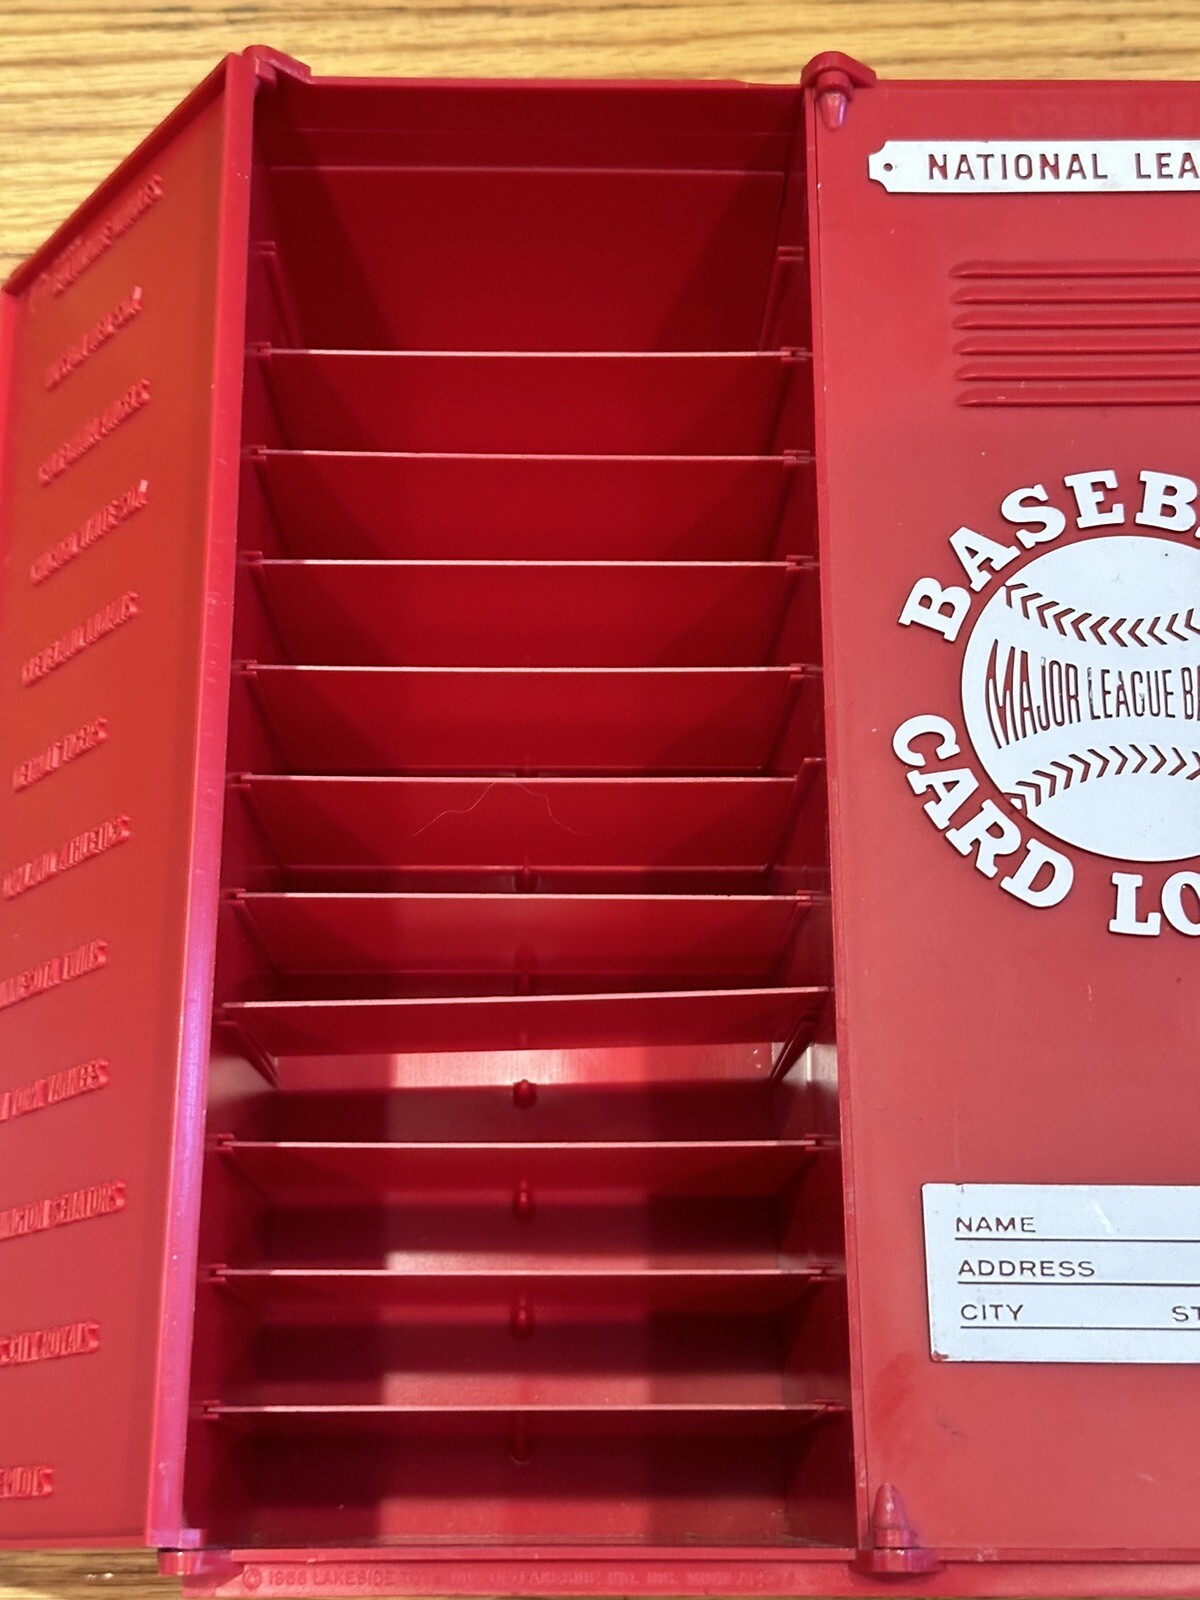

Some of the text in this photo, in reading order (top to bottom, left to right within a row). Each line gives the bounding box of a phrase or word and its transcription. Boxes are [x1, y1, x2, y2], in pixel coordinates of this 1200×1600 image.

[928, 152, 1200, 181] NATIONAL LEA
[899, 469, 1200, 642] BASEB
[985, 639, 1200, 749] MAJOR LEAGUE B
[892, 714, 1074, 907] CARD
[955, 1216, 1036, 1233] NAME
[958, 1259, 1095, 1277] ADDRESS
[960, 1304, 1024, 1321] CITY
